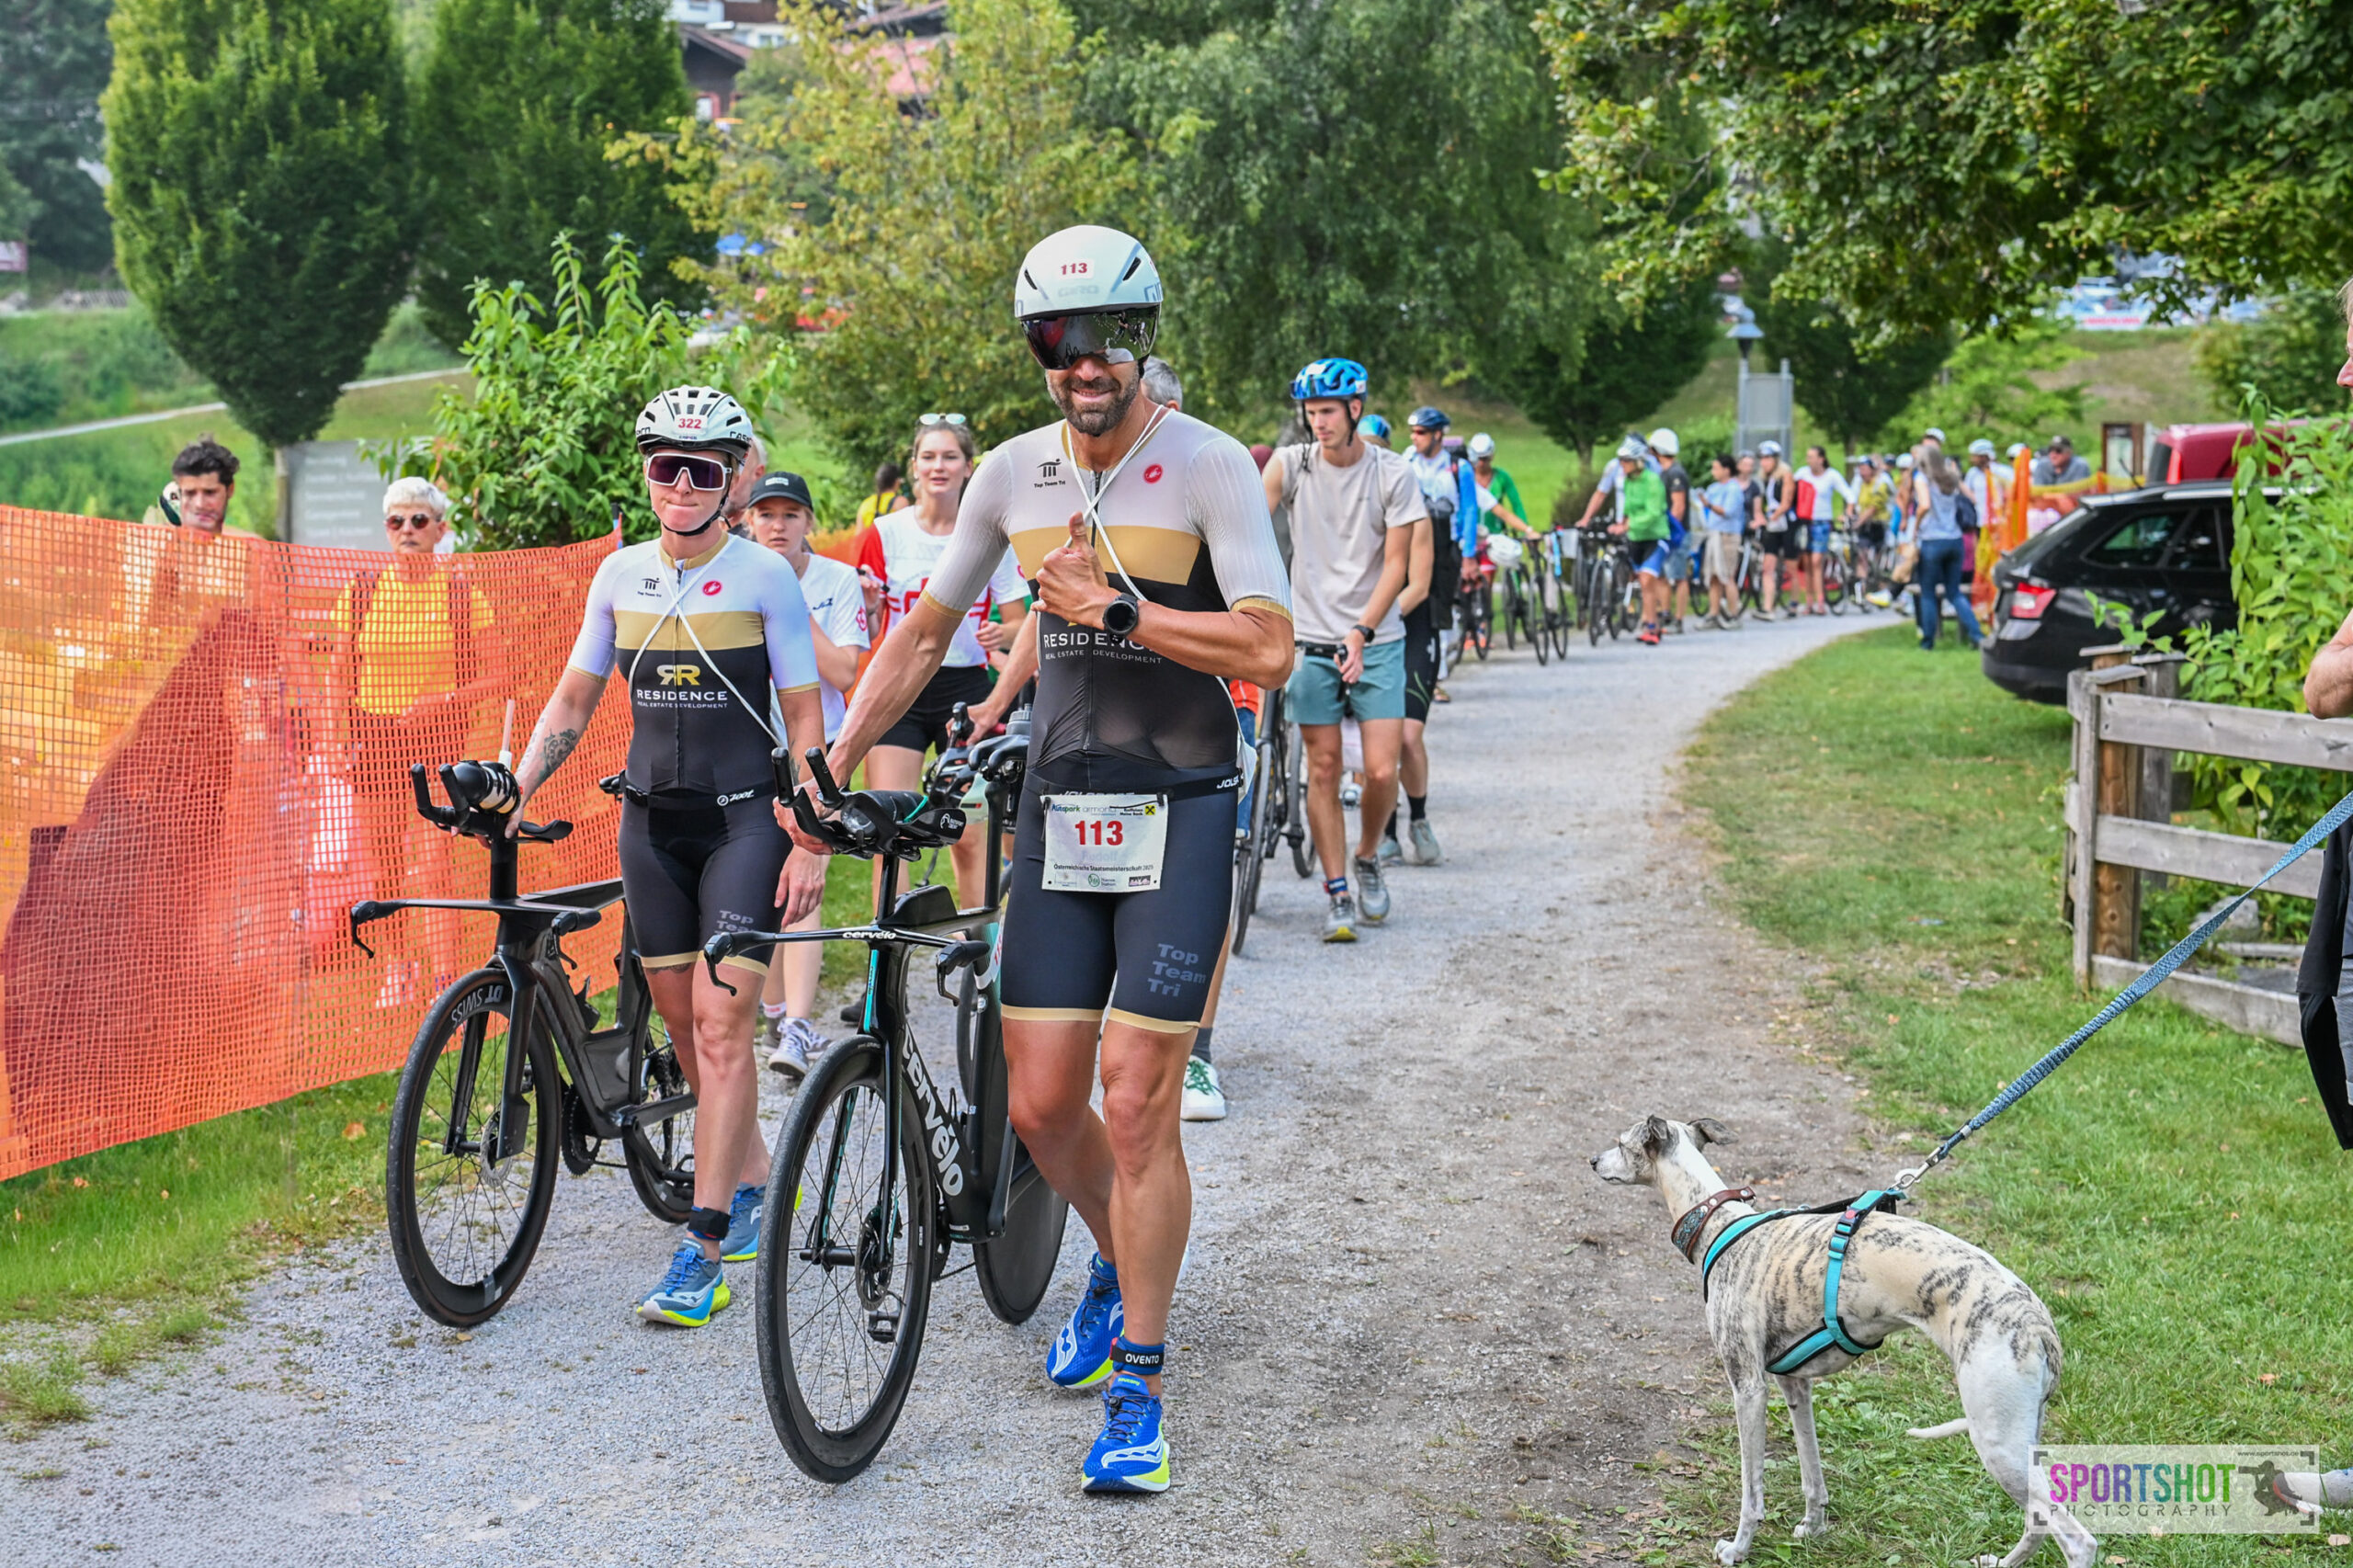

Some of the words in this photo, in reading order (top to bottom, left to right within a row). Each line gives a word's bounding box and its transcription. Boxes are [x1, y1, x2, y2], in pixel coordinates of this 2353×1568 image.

[1061, 262, 1088, 276] 113
[678, 418, 702, 429] 322
[1057, 650, 1085, 658] ESTATE
[1092, 649, 1163, 664] DEVELOPMENT
[636, 689, 728, 701] RESIDENCE
[1074, 820, 1124, 846] 113
[719, 910, 754, 925] Top
[716, 920, 756, 933] Tea
[1157, 943, 1199, 966] Top
[1152, 960, 1206, 984] Team
[484, 984, 504, 1004] DT
[1147, 977, 1181, 997] Tri
[451, 988, 483, 1028] SWISS
[902, 1022, 963, 1196] cervélo
[1125, 1352, 1160, 1365] OVENTO
